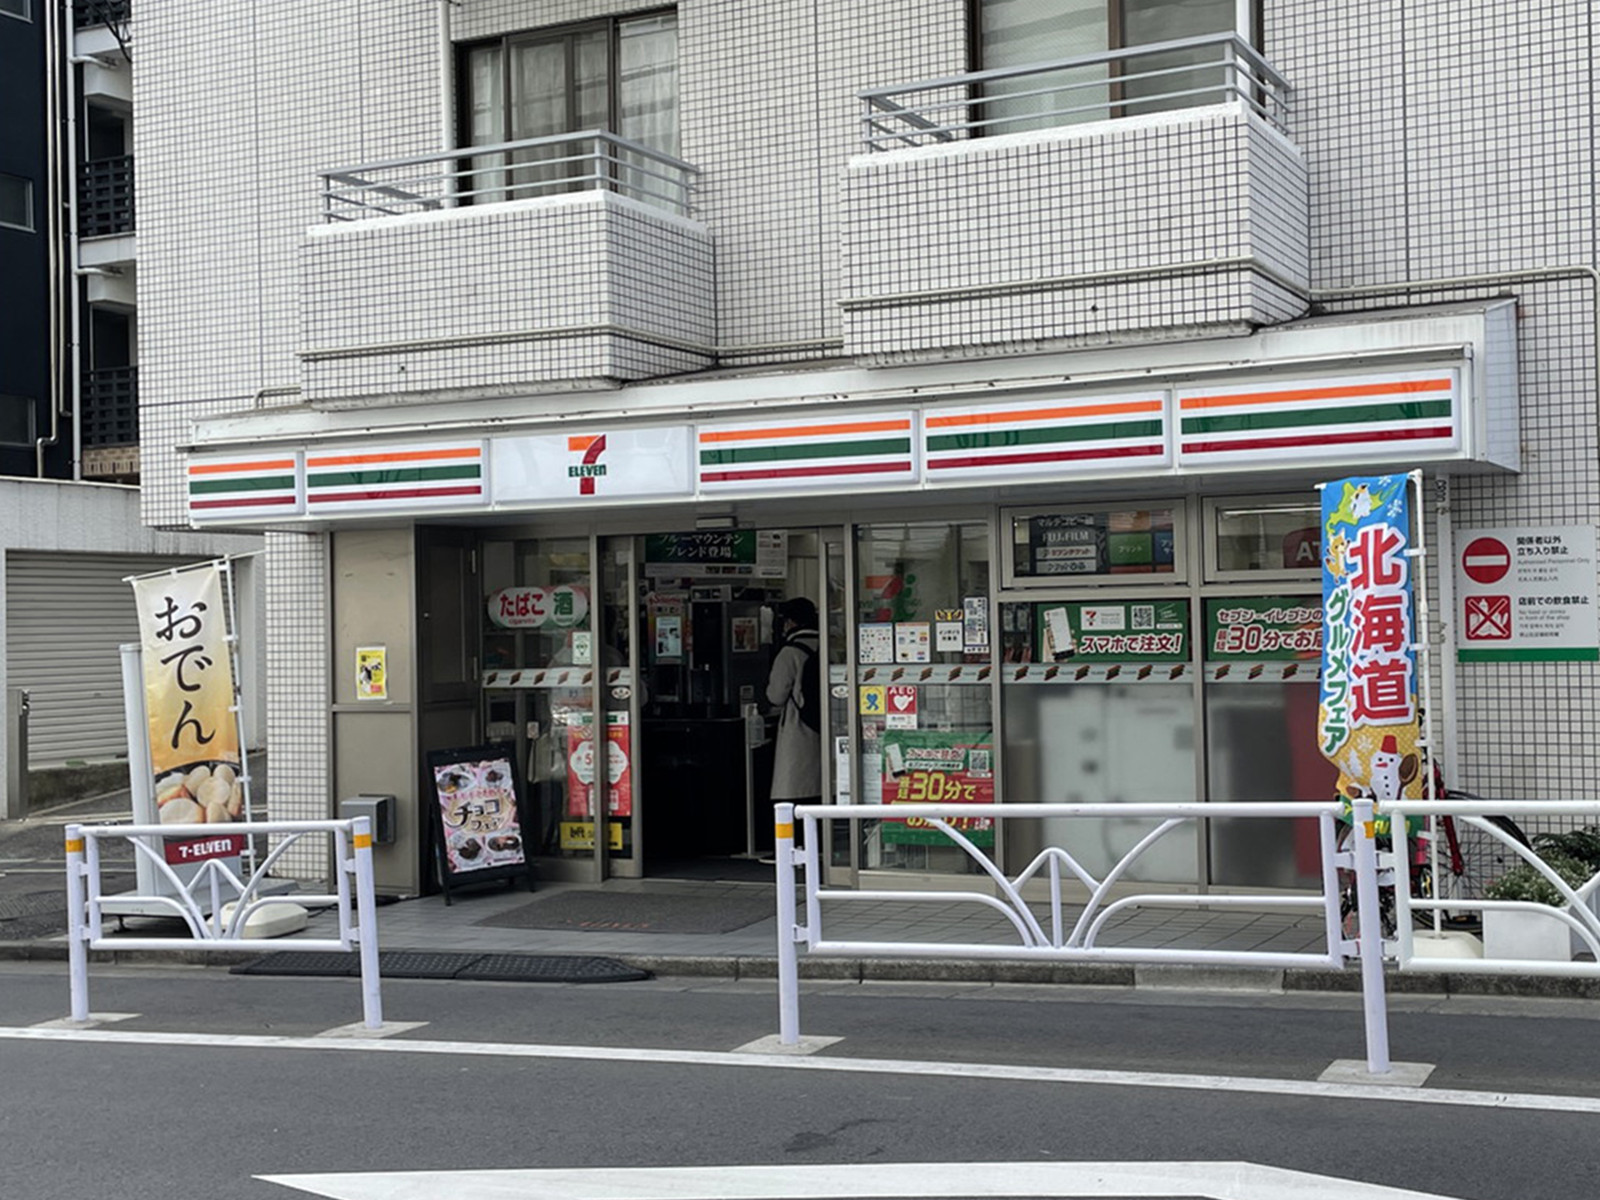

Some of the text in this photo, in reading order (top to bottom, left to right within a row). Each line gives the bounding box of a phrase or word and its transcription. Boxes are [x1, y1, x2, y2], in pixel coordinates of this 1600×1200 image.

[1516, 536, 1561, 546] 関係者以外
[1517, 546, 1568, 556] 立ち入り禁止
[500, 592, 545, 617] たばこ
[553, 591, 573, 615] 酒
[1518, 596, 1590, 606] 店前での飲食禁止
[1349, 528, 1410, 722] 北海道
[1081, 634, 1181, 652] スマホで注文!
[155, 597, 216, 749] おでん
[1325, 588, 1349, 753] グルメフェア
[889, 686, 915, 695] AED
